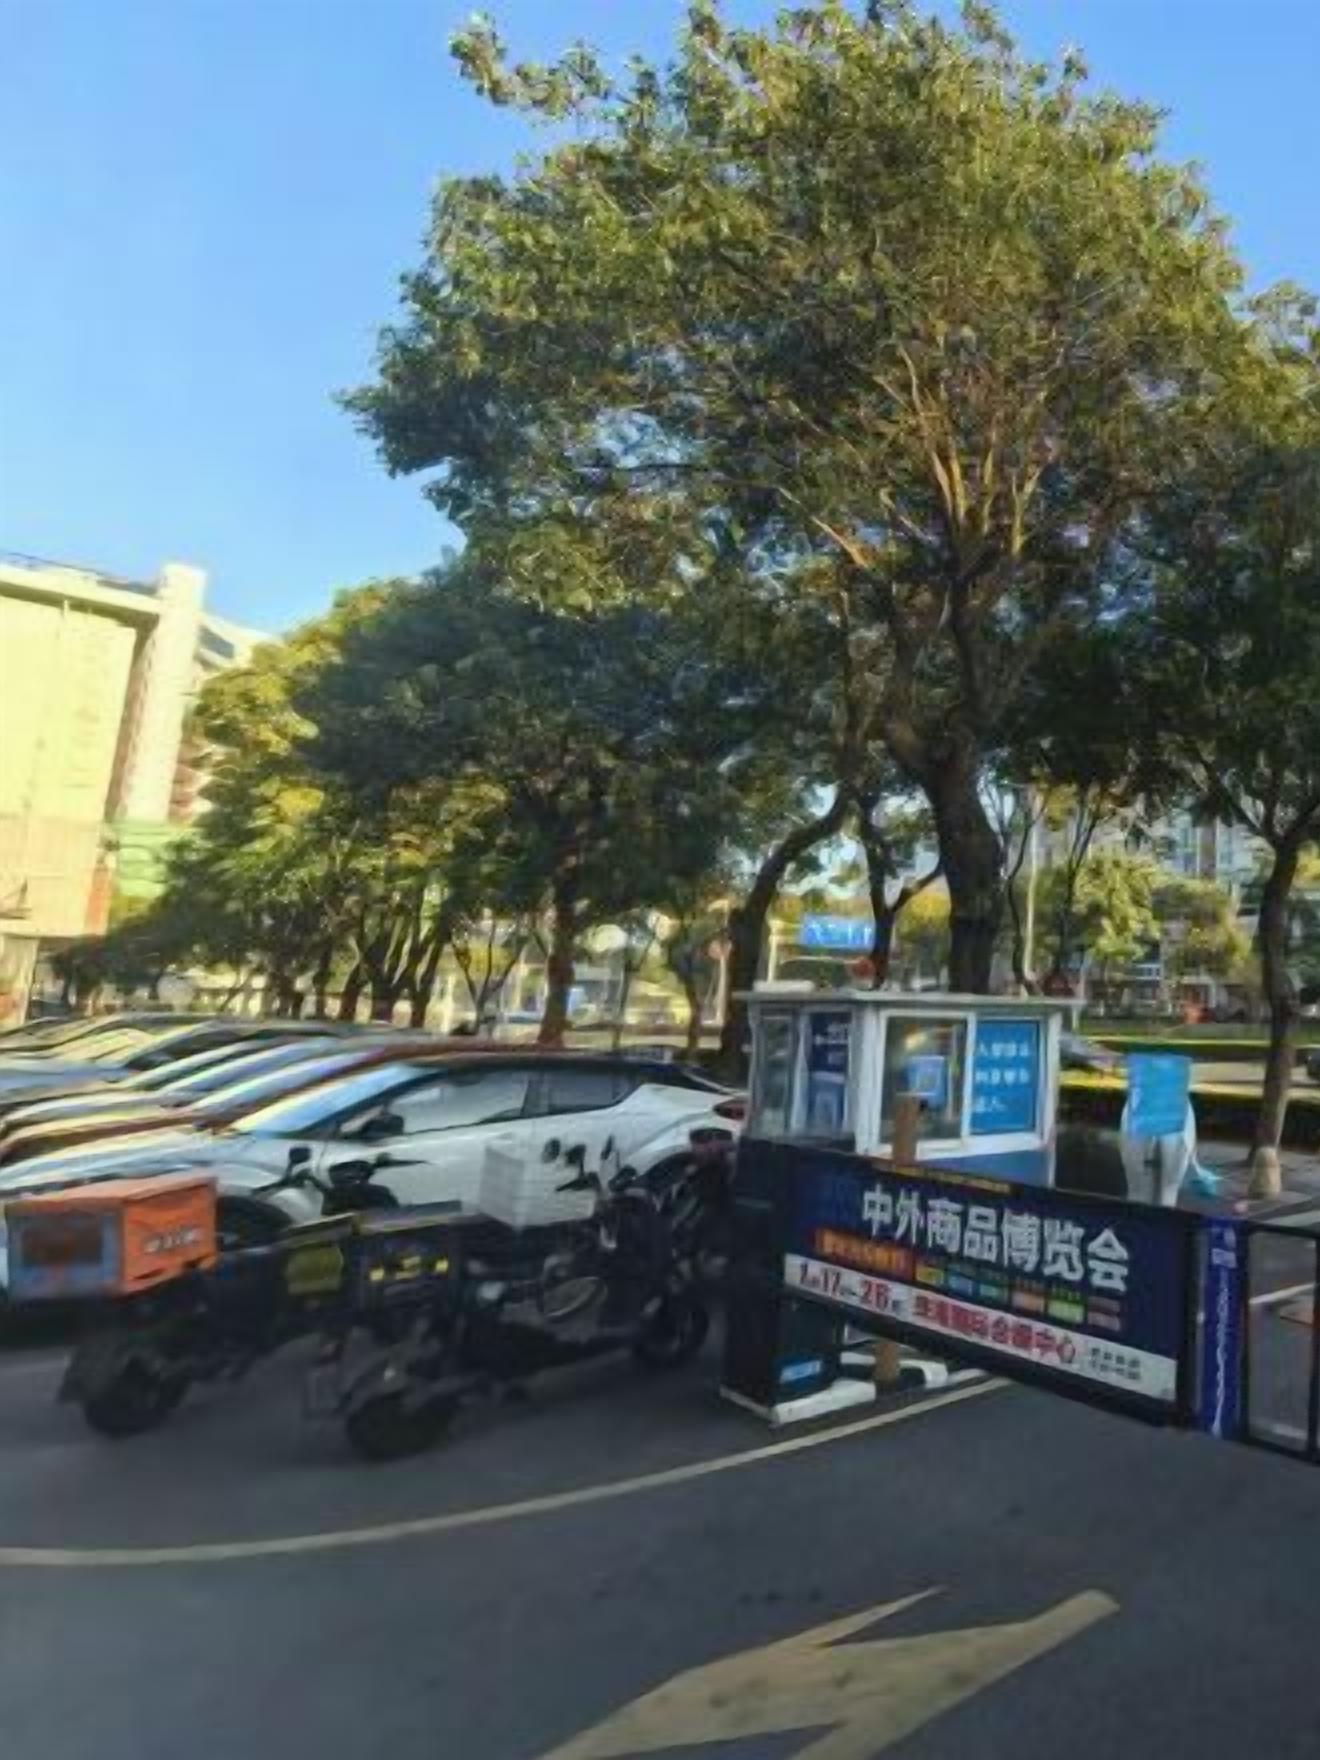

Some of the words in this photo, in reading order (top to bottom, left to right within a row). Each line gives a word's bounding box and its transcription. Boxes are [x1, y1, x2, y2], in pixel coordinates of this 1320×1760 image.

[861, 1181, 1130, 1292] 中外商品博览会
